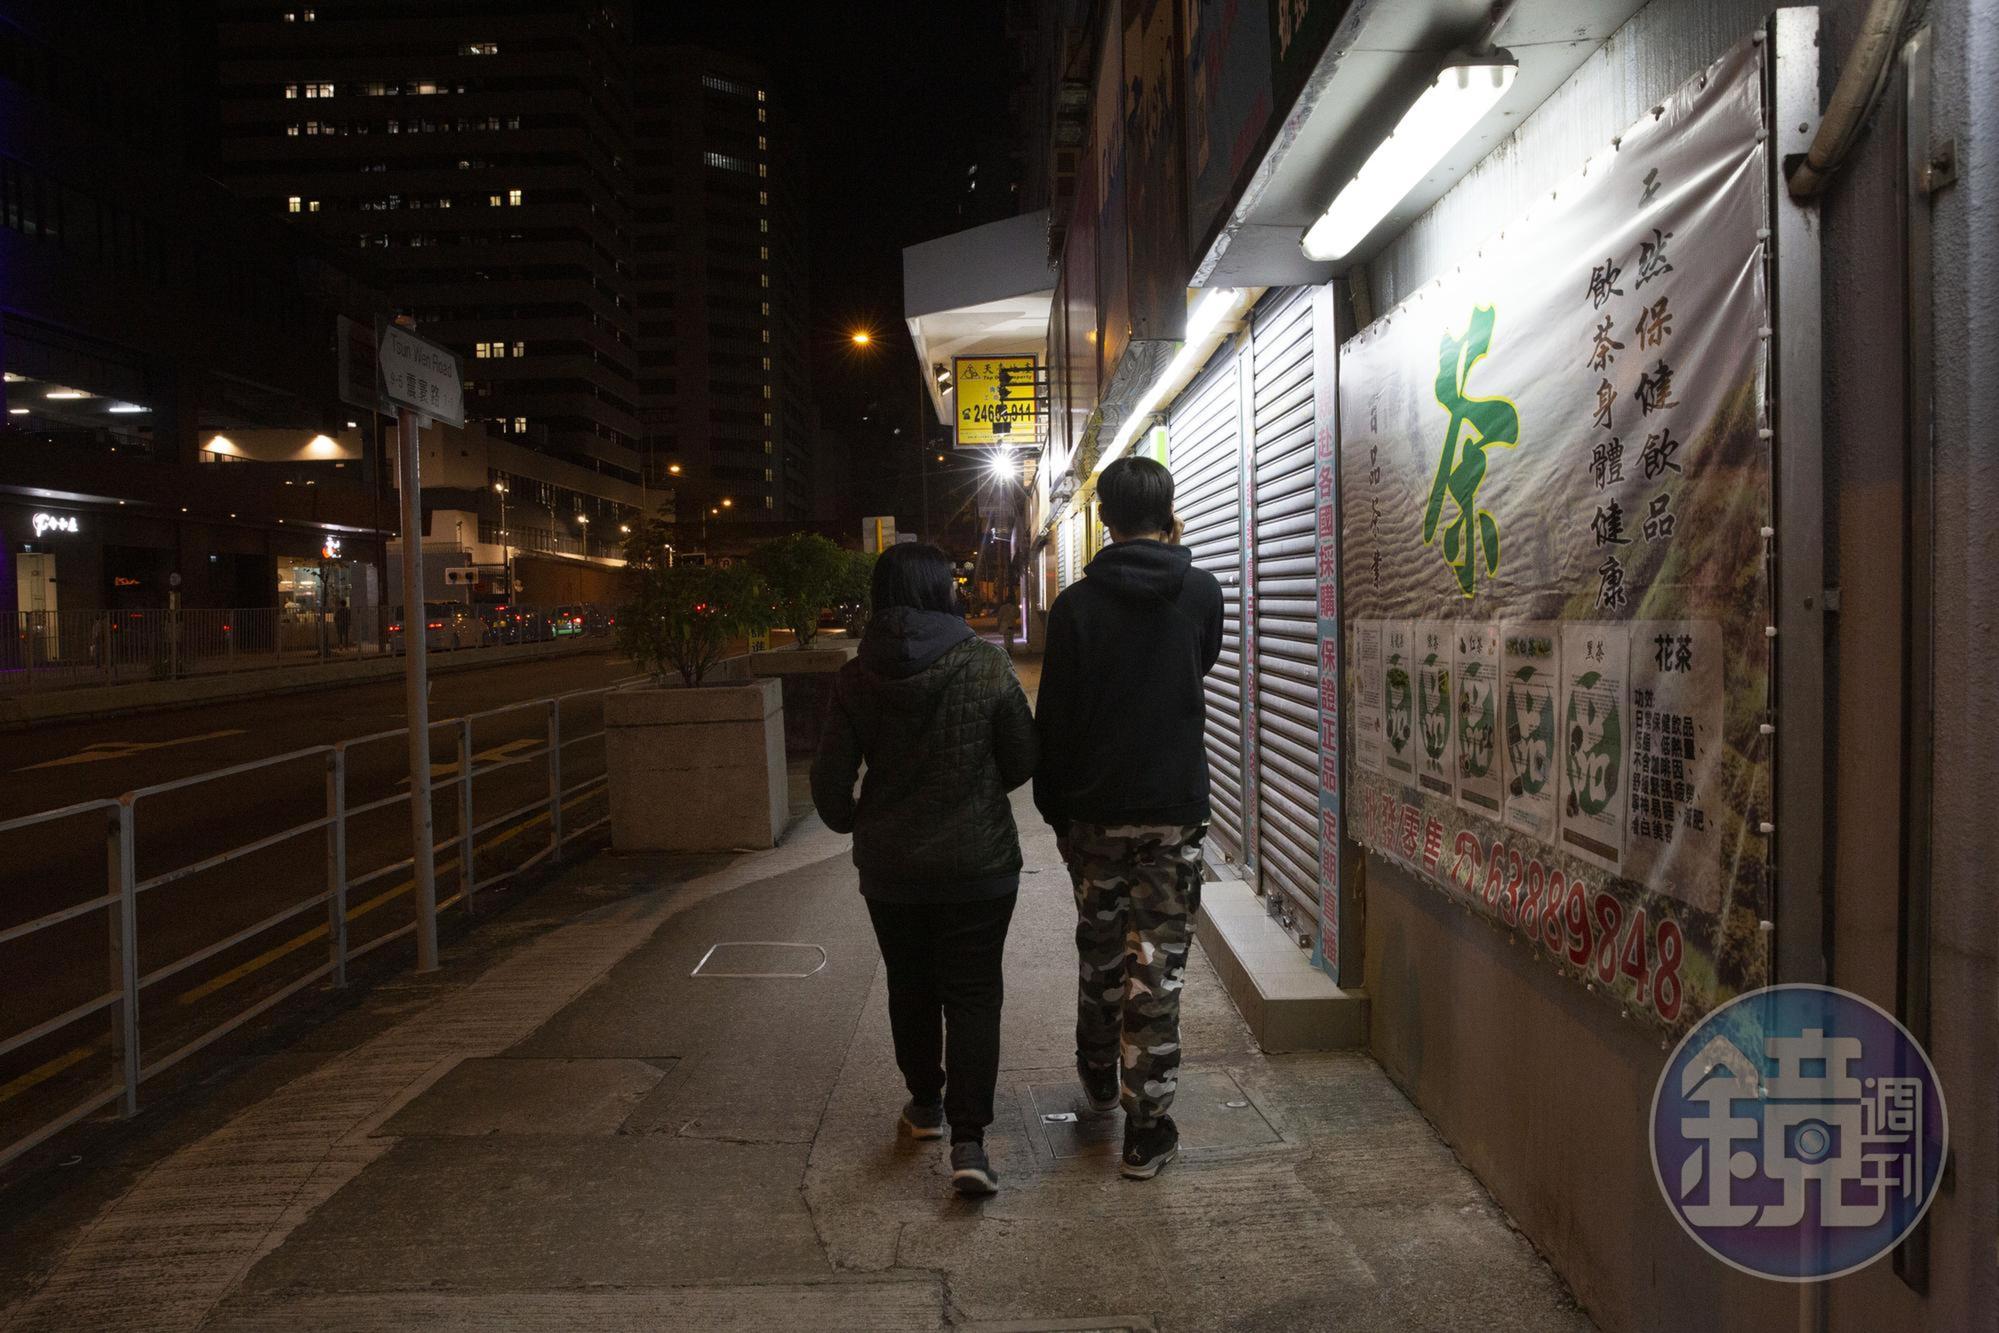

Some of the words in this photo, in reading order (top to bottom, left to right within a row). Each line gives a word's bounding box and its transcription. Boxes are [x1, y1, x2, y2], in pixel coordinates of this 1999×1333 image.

[391, 332, 412, 358] Tsun
[413, 346, 431, 369] Wen
[432, 354, 452, 378] Road
[1585, 256, 1633, 610] 飲茶身體健康
[1318, 386, 1336, 619] 赴各國採購
[1654, 633, 1693, 673] 花茶
[1482, 841, 1684, 1022] 63889848
